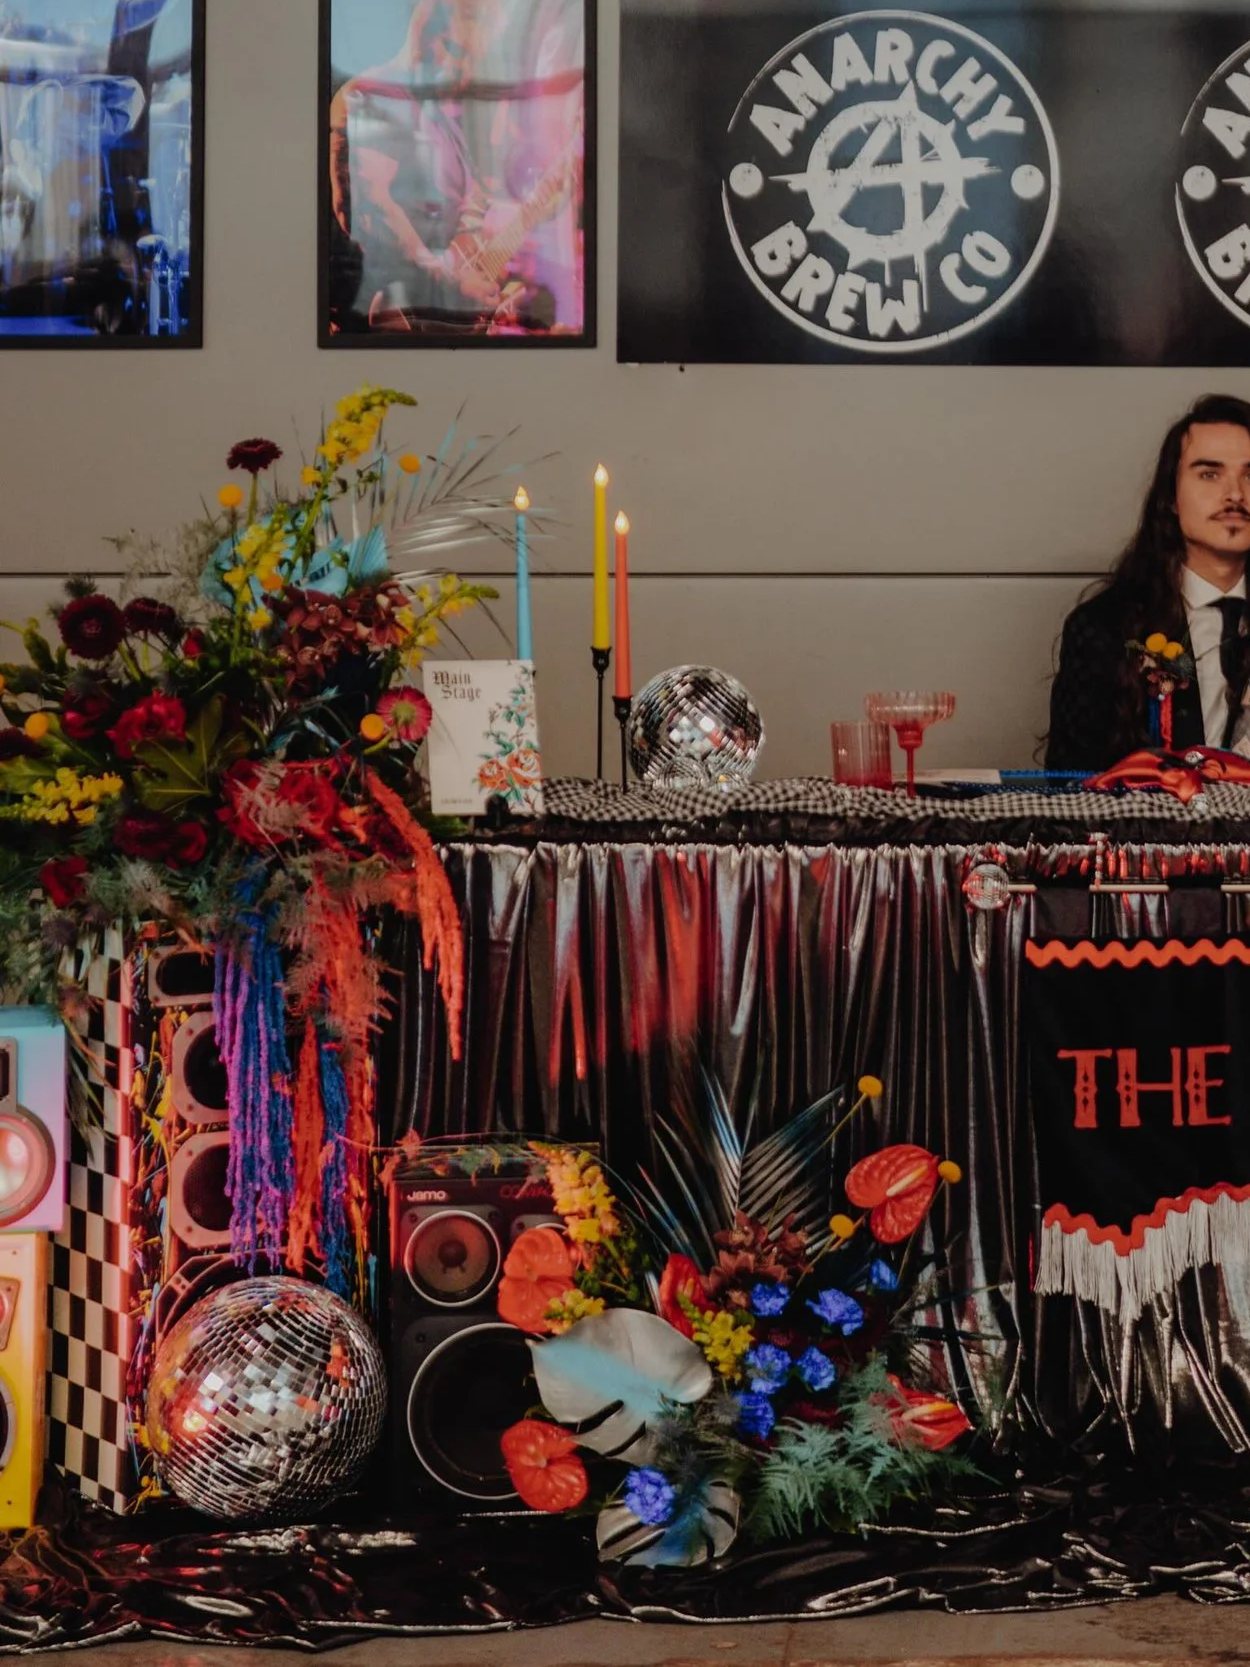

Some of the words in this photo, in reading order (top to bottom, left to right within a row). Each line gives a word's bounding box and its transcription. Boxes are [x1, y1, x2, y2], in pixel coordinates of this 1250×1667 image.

[750, 28, 1026, 157] ANARCHY
[750, 220, 921, 338] BREW
[939, 230, 1012, 304] CO
[432, 670, 472, 687] Main
[441, 685, 482, 701] Stage
[1057, 1045, 1231, 1129] THE
